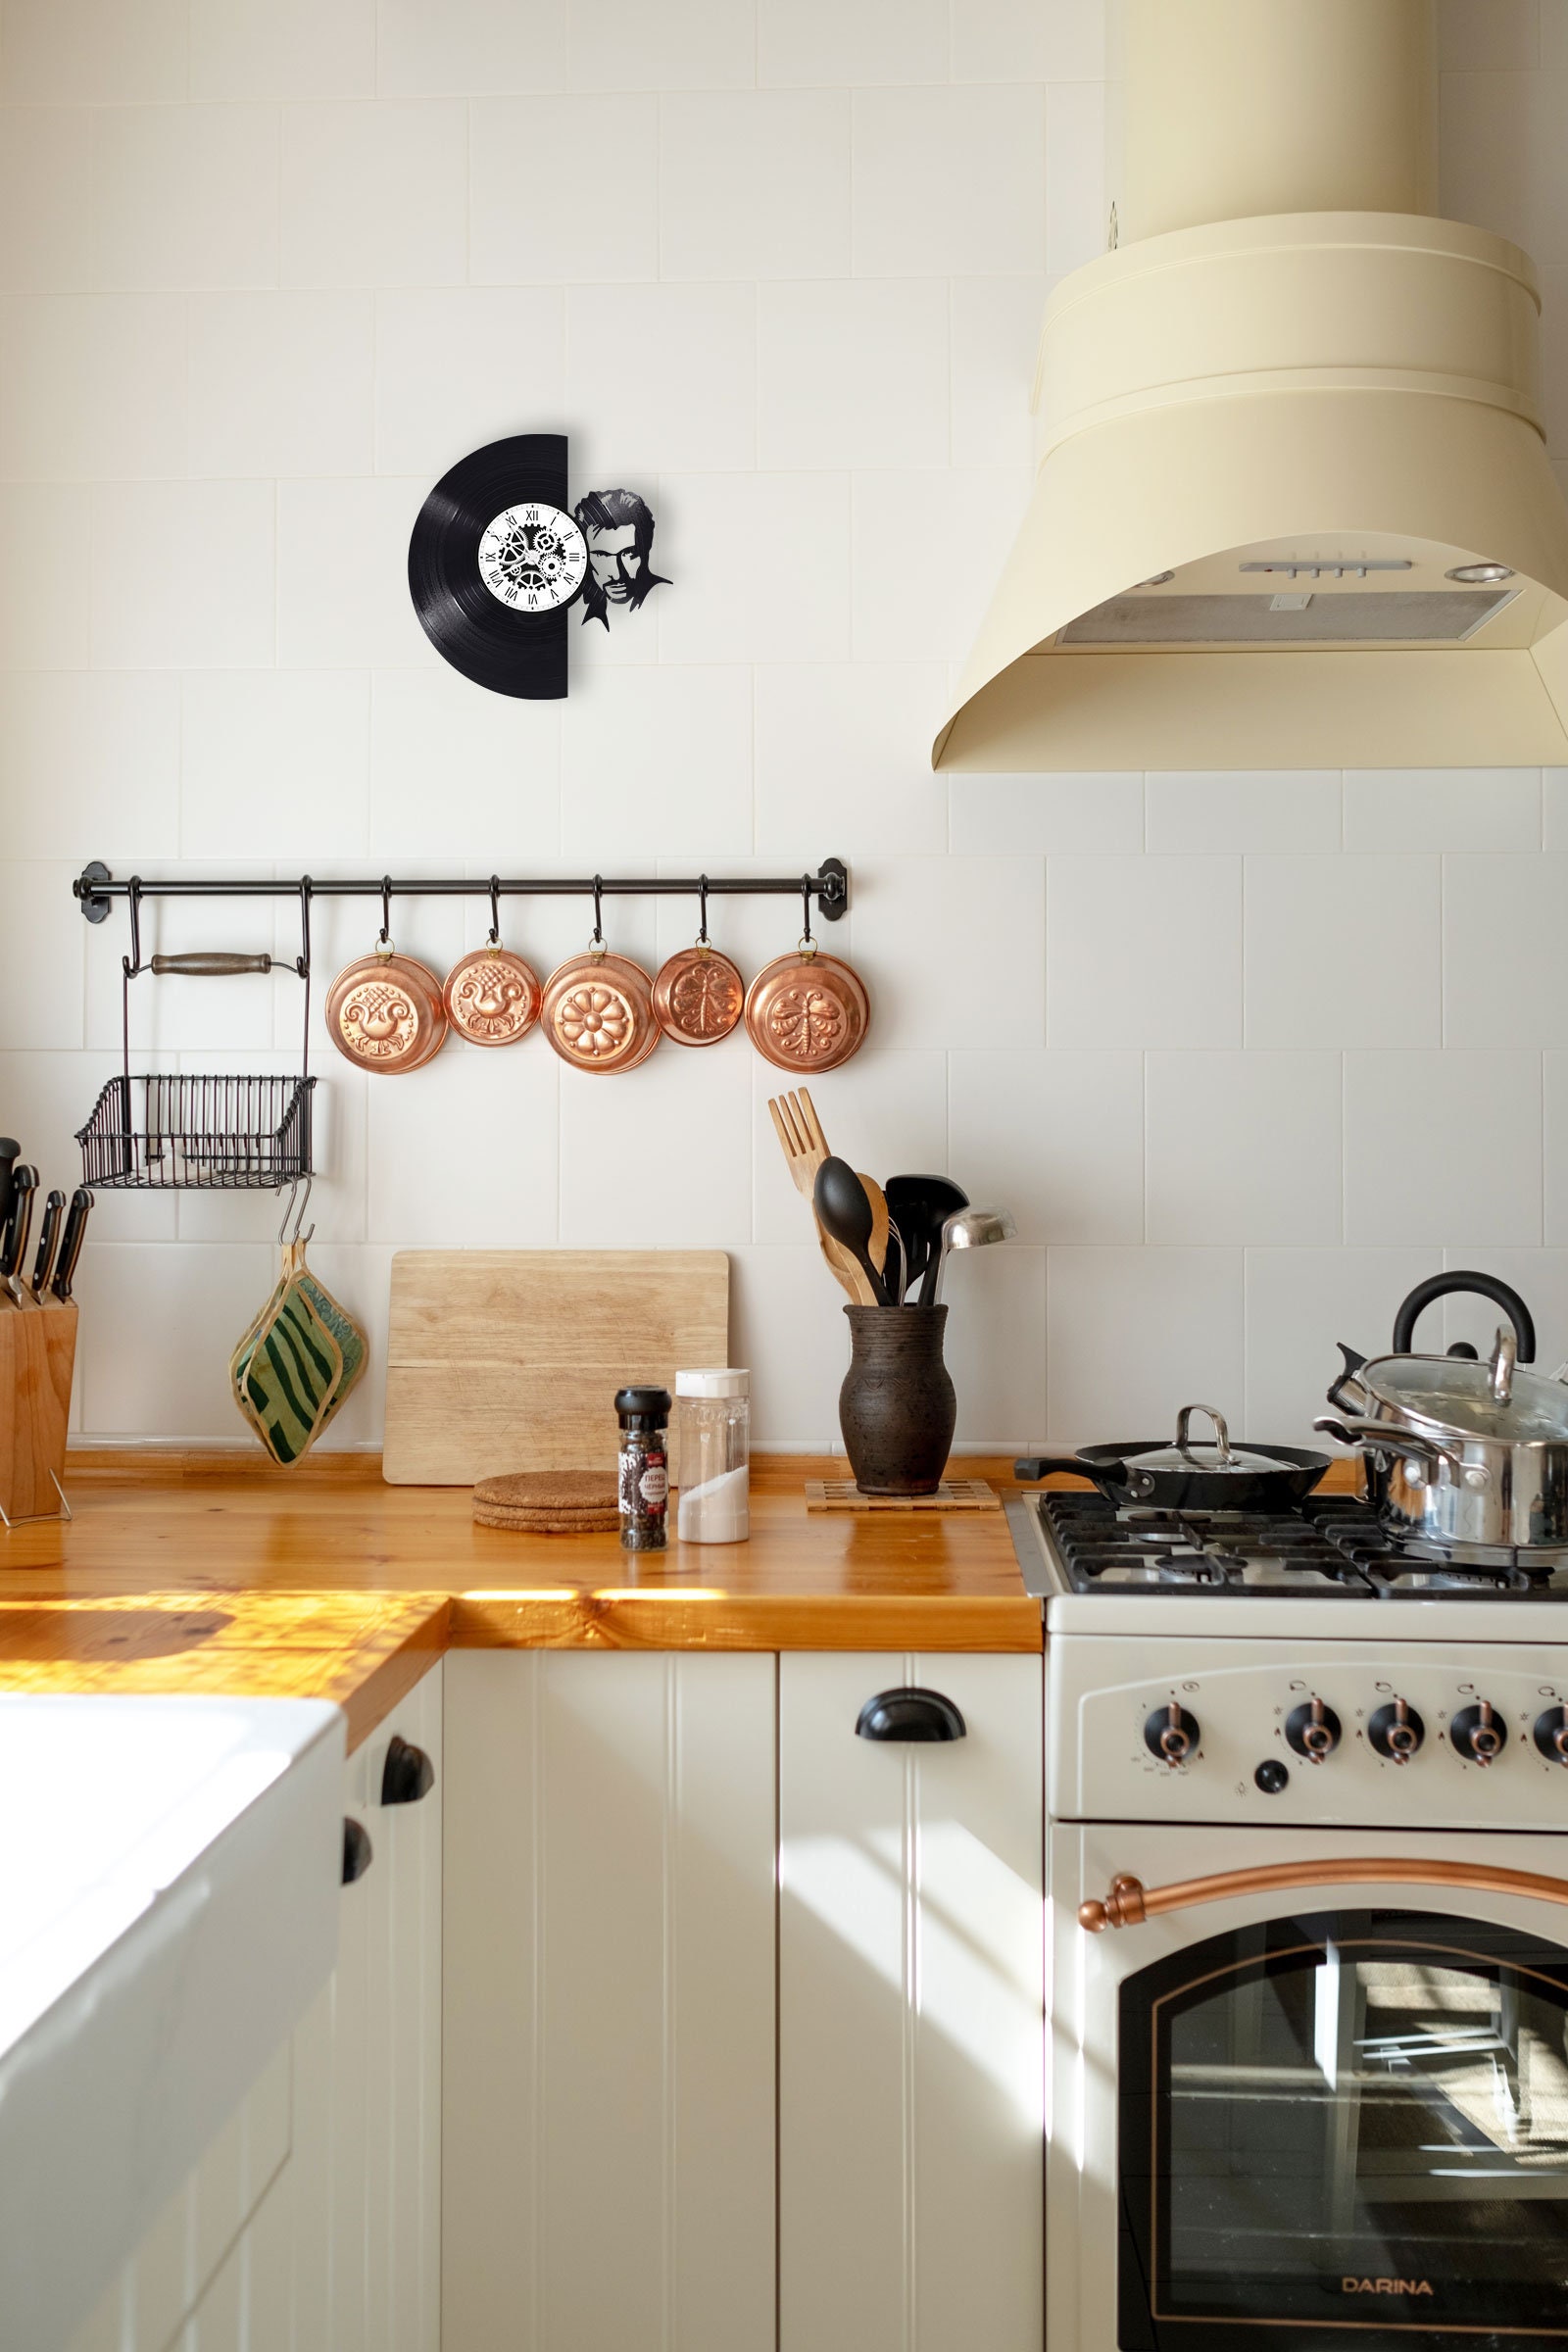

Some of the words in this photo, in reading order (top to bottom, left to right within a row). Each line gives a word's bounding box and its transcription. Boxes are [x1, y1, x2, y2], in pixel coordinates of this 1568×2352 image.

[525, 511, 539, 521] XII
[563, 532, 574, 541] II
[485, 553, 497, 563] IX
[568, 553, 580, 562] III
[563, 572, 575, 585] IV
[505, 586, 518, 602] VII
[550, 589, 559, 600] V
[528, 594, 538, 605] VI
[645, 1473, 665, 1482] ПЕРЕЦ
[1342, 2277, 1434, 2295] DARINA
